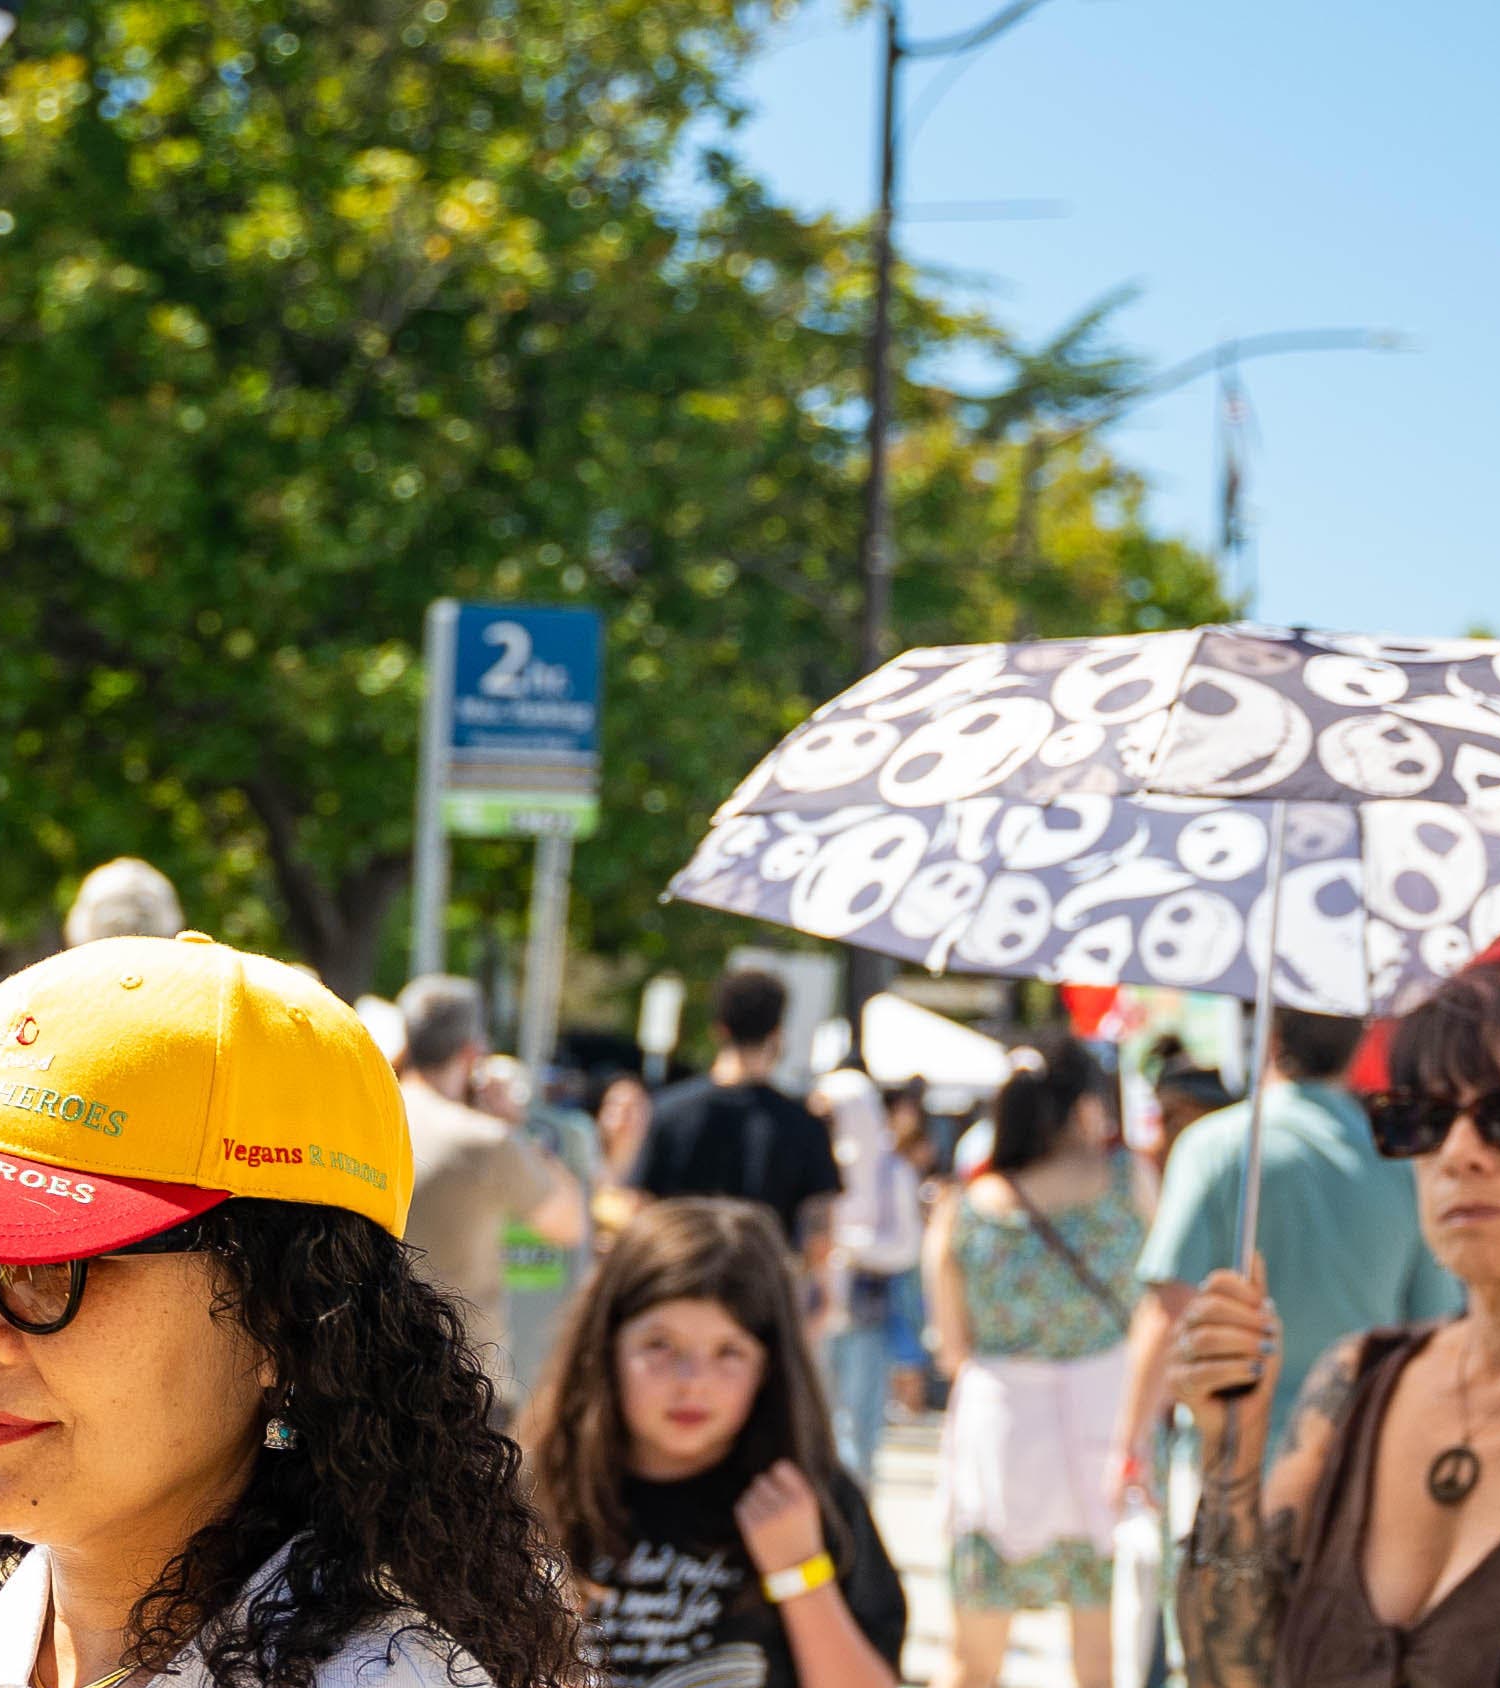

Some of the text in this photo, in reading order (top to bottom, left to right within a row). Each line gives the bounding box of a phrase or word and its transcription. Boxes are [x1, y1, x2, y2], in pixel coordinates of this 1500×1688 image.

[478, 619, 533, 699] 2
[222, 1137, 304, 1168] Vegans
[328, 1151, 388, 1191] HEROES
